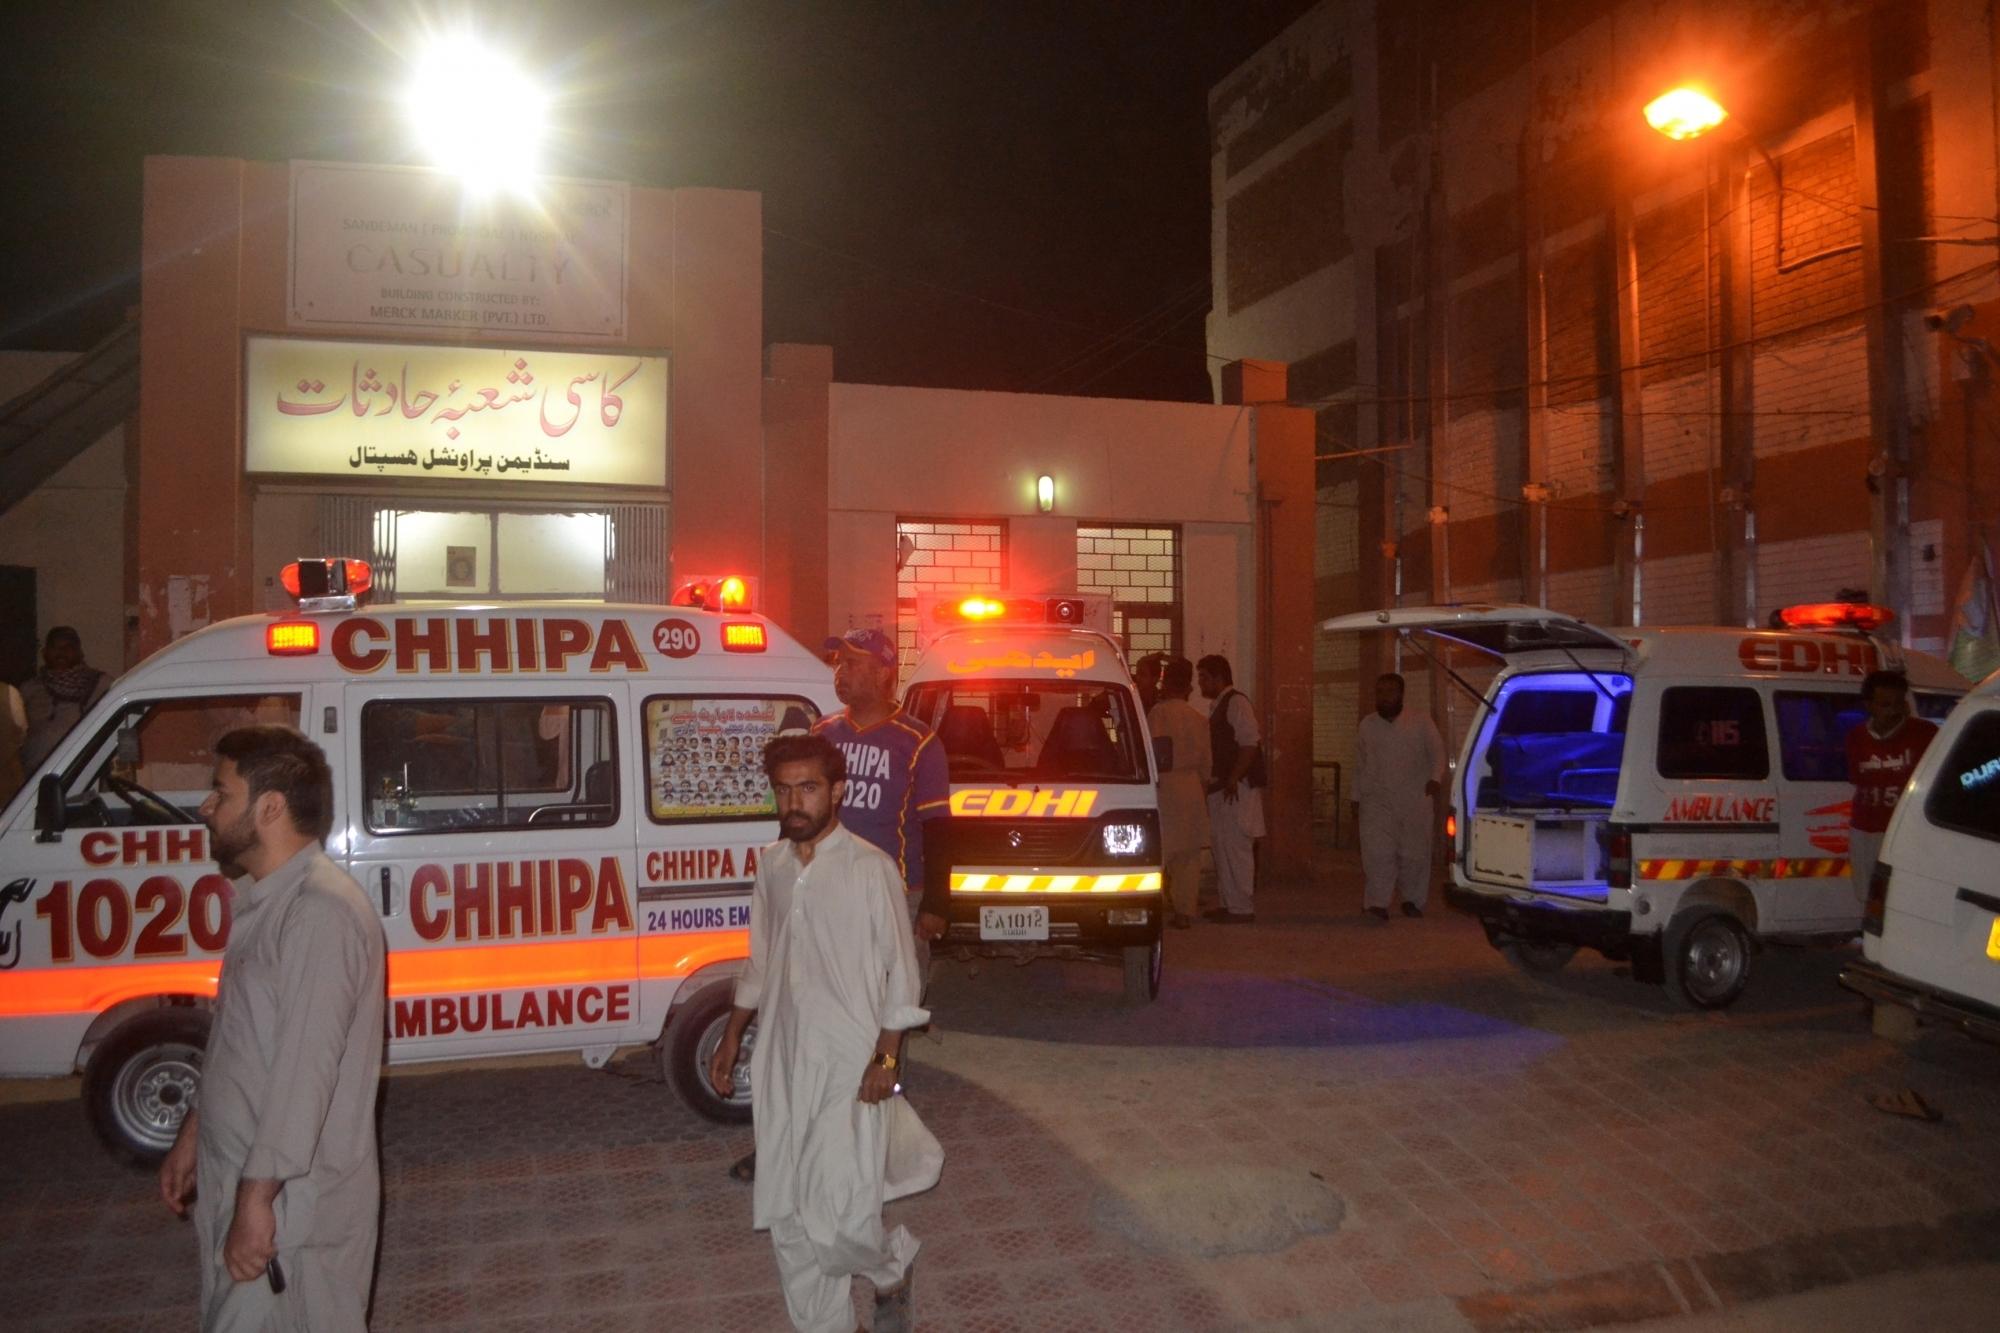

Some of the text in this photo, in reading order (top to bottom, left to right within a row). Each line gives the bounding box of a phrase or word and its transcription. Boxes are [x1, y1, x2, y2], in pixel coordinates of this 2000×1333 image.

[431, 222, 505, 241] PROCIAL
[345, 242, 571, 285] CASUALTY
[380, 287, 434, 301] BUILDING
[437, 290, 518, 306] CONSTRUCTED
[370, 304, 417, 319] MERCK
[420, 307, 479, 322] MARKER
[522, 312, 551, 327] LTD.
[276, 358, 441, 419] حادثات
[330, 617, 648, 674] CHHIPA
[657, 627, 697, 650] 290
[1738, 637, 1878, 675] EDHI
[835, 741, 891, 781] HIPA
[1960, 756, 2000, 788] DUR
[949, 789, 1098, 817] EDHI
[1663, 795, 1777, 823] AMBULANCE
[646, 847, 737, 882] CHHIPA
[409, 856, 635, 942] CHHIPA
[36, 873, 236, 963] 1020
[647, 910, 667, 932] 24
[671, 907, 725, 931] HOURS
[386, 984, 630, 1039] MBULANCE
